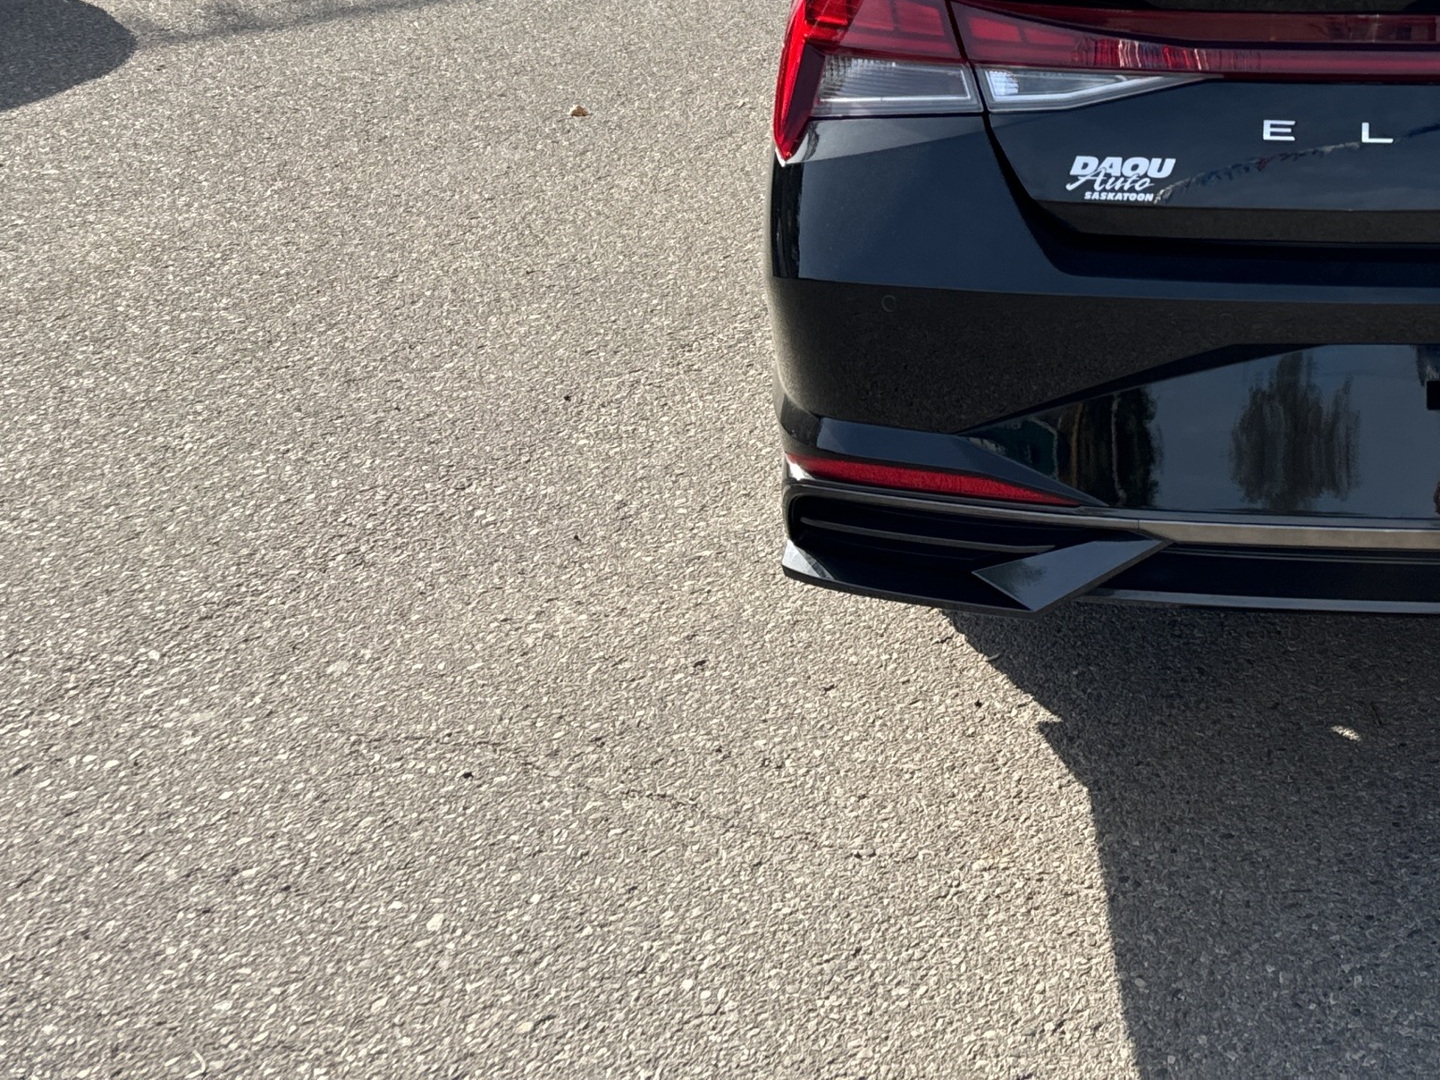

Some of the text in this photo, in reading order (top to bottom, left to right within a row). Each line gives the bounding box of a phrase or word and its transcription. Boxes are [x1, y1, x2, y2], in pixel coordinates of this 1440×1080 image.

[1065, 166, 1155, 191] Auto
[1069, 155, 1177, 179] DAOU
[1083, 191, 1154, 202] SASKATOON
